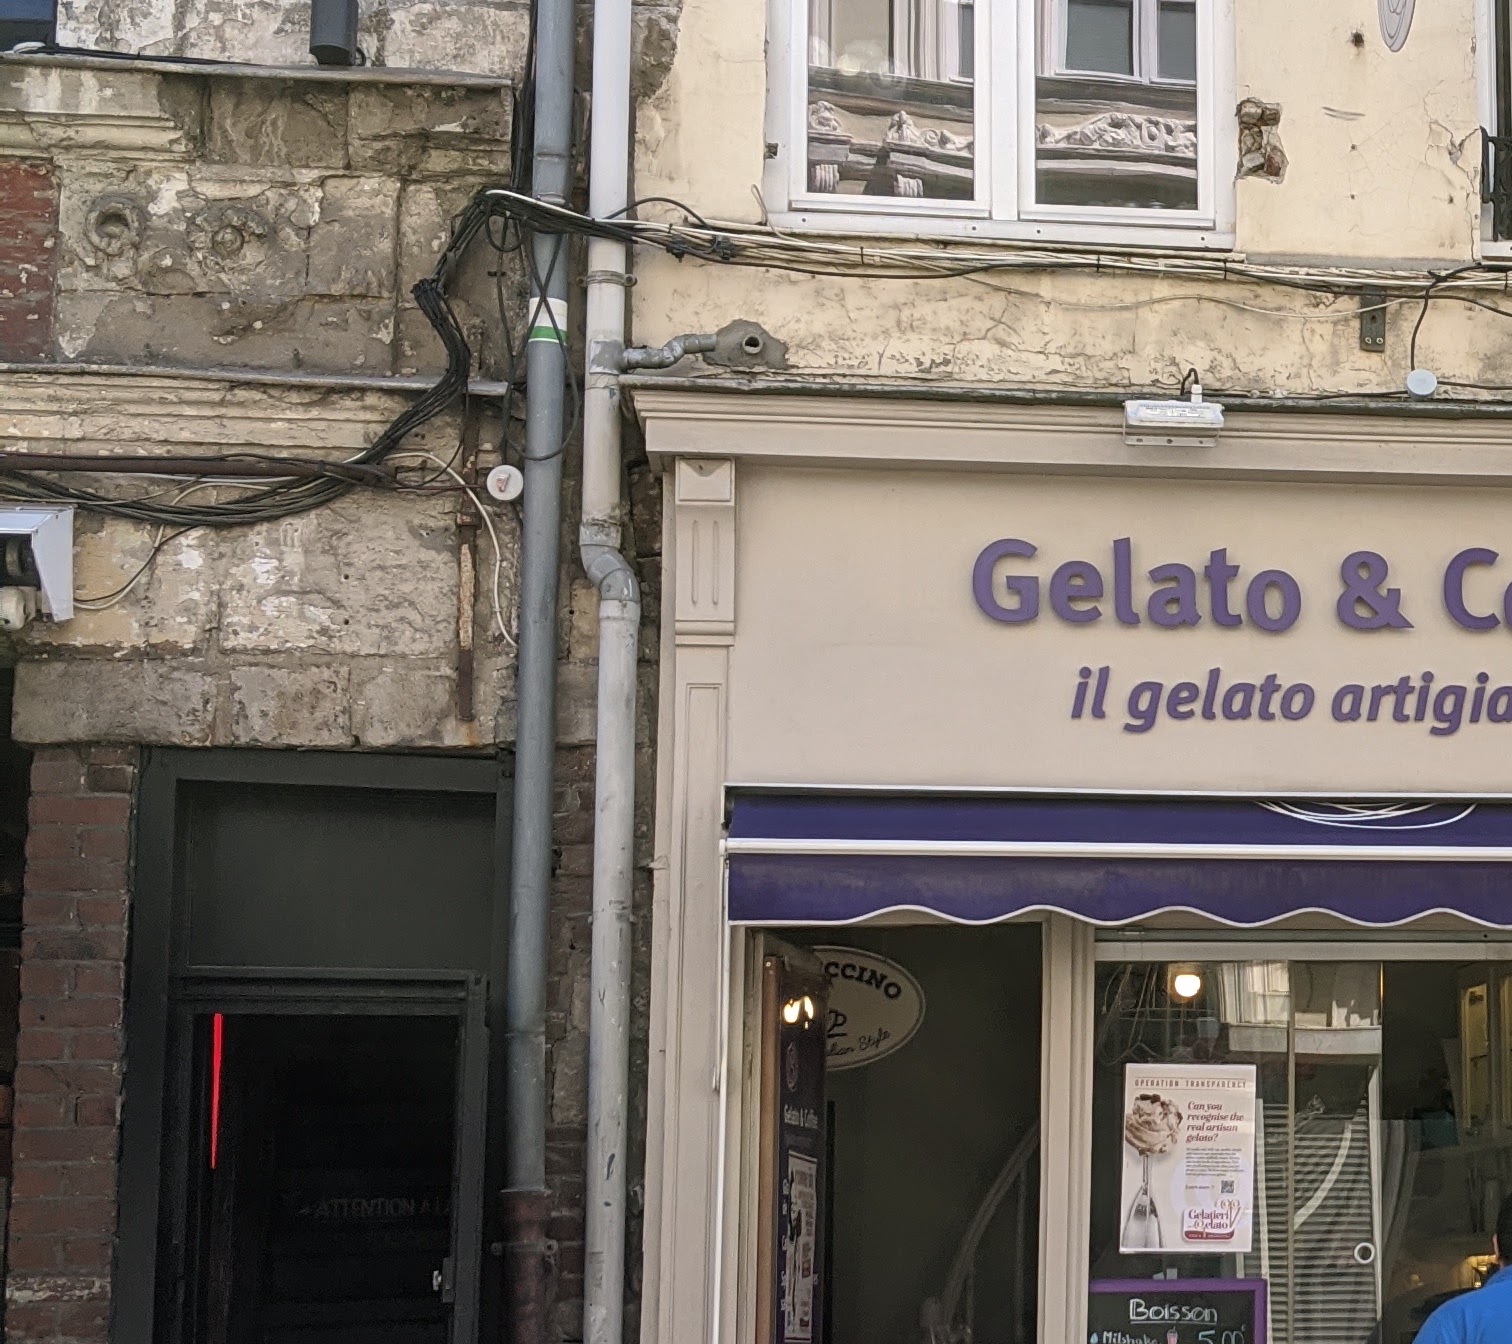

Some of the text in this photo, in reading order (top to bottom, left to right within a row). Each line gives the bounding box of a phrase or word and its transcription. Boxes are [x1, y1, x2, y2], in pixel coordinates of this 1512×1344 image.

[971, 536, 1303, 633] Gelato
[1335, 549, 1415, 630] &
[1070, 666, 1111, 720] il
[1123, 668, 1315, 735] gelato
[824, 961, 902, 999] CCINO
[1134, 1078, 1247, 1089] OPERATION TRANSPARENCY
[1187, 1101, 1205, 1111] Can
[1186, 1111, 1245, 1123] recognise the
[1186, 1122, 1238, 1132] real artisan
[1128, 1298, 1218, 1322] Boisson
